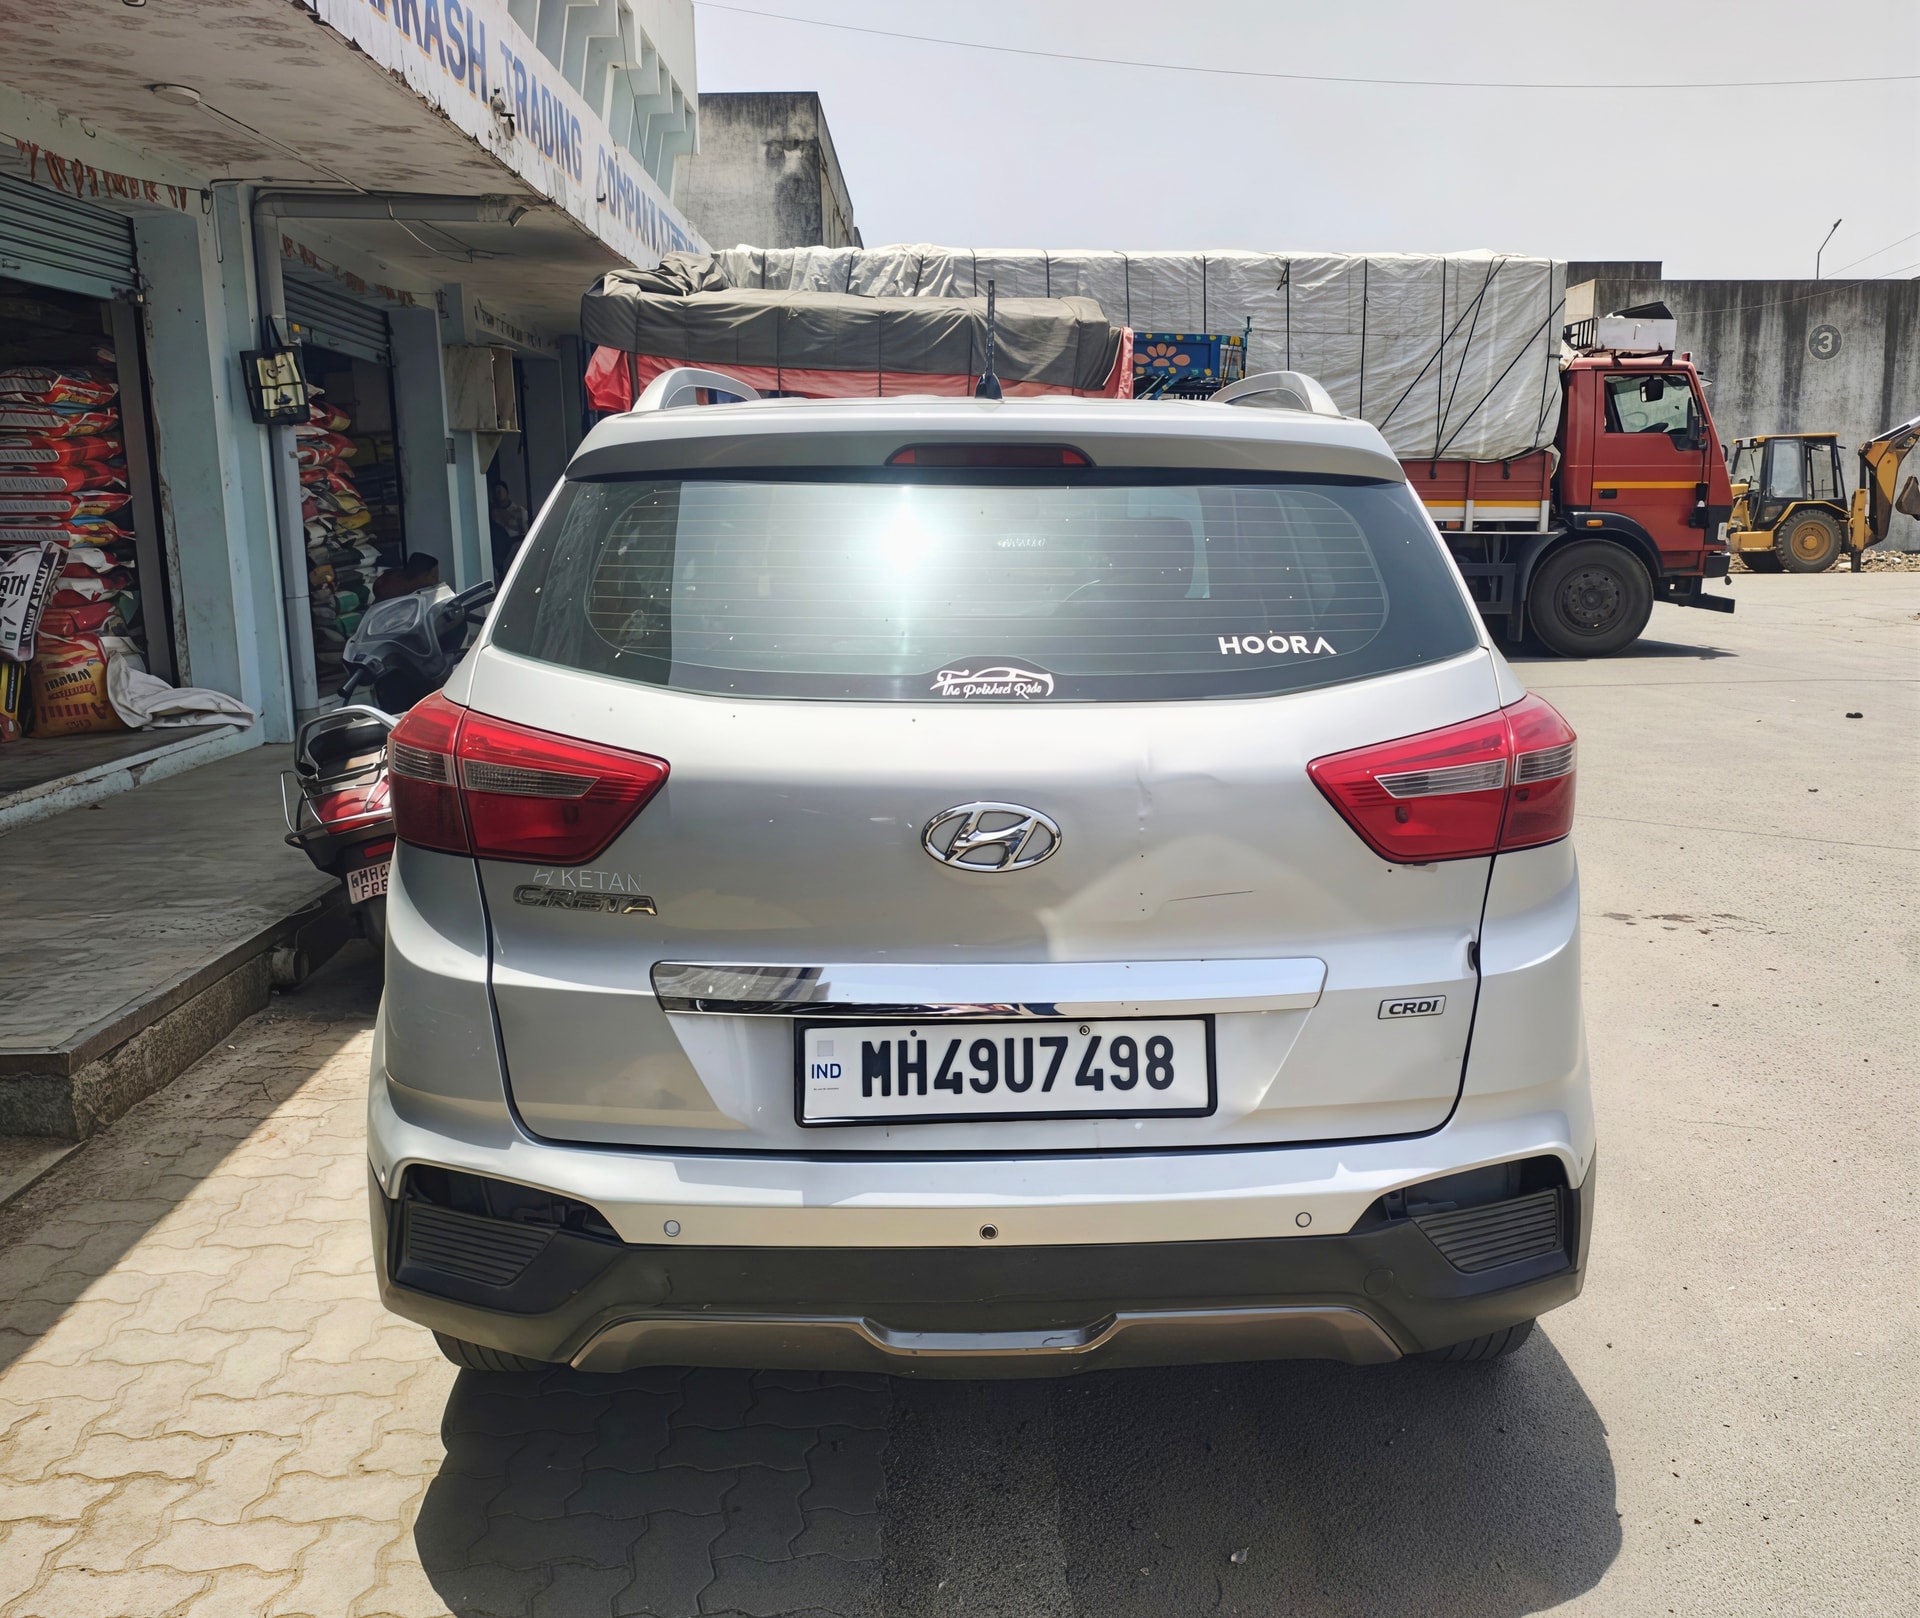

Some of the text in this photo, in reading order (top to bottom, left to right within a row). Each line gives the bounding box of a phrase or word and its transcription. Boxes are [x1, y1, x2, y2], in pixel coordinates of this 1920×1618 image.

[500, 40, 583, 182] TRADING
[1817, 331, 1833, 353] 3
[1218, 635, 1338, 655] HOORA
[561, 869, 642, 892] KETAN
[513, 884, 658, 916] CRETA
[1388, 1000, 1440, 1015] CRDI
[811, 1063, 842, 1079] IND
[862, 1035, 1175, 1097] MH49U7498
